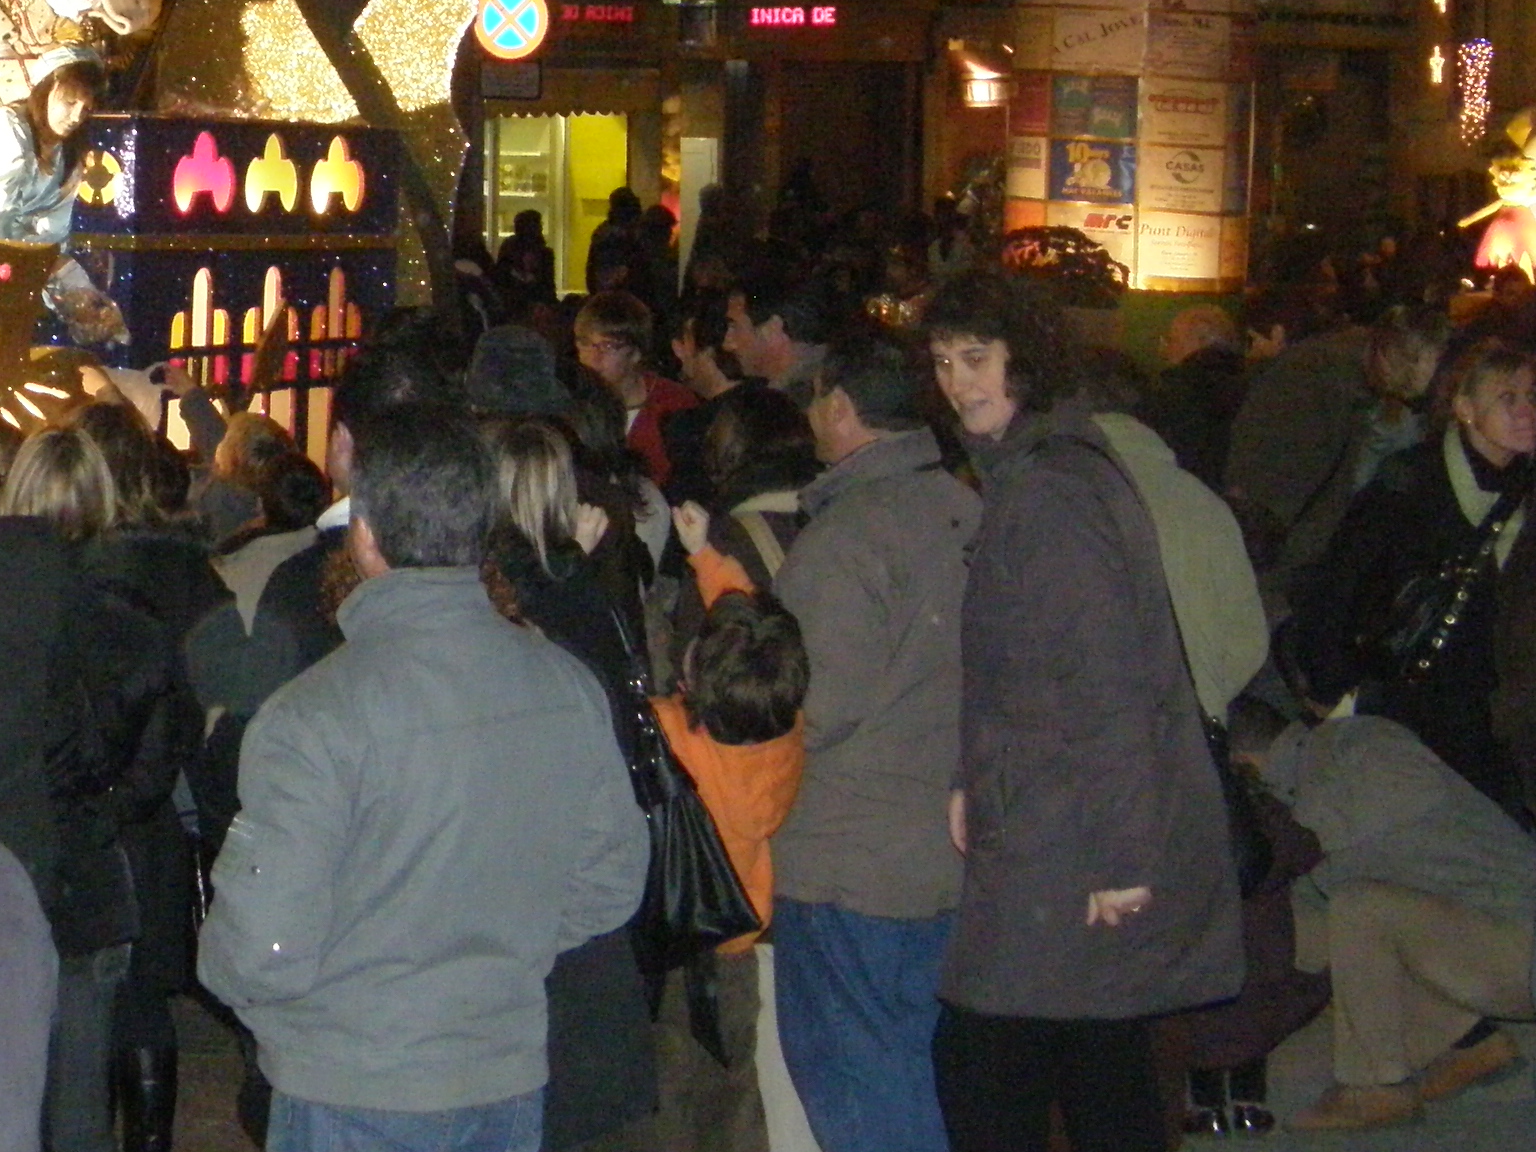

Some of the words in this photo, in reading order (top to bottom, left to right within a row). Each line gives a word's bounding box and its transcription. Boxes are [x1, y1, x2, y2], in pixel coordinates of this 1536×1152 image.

[750, 5, 805, 25] INICA
[811, 5, 837, 24] DE
[1165, 160, 1205, 174] CASAS
